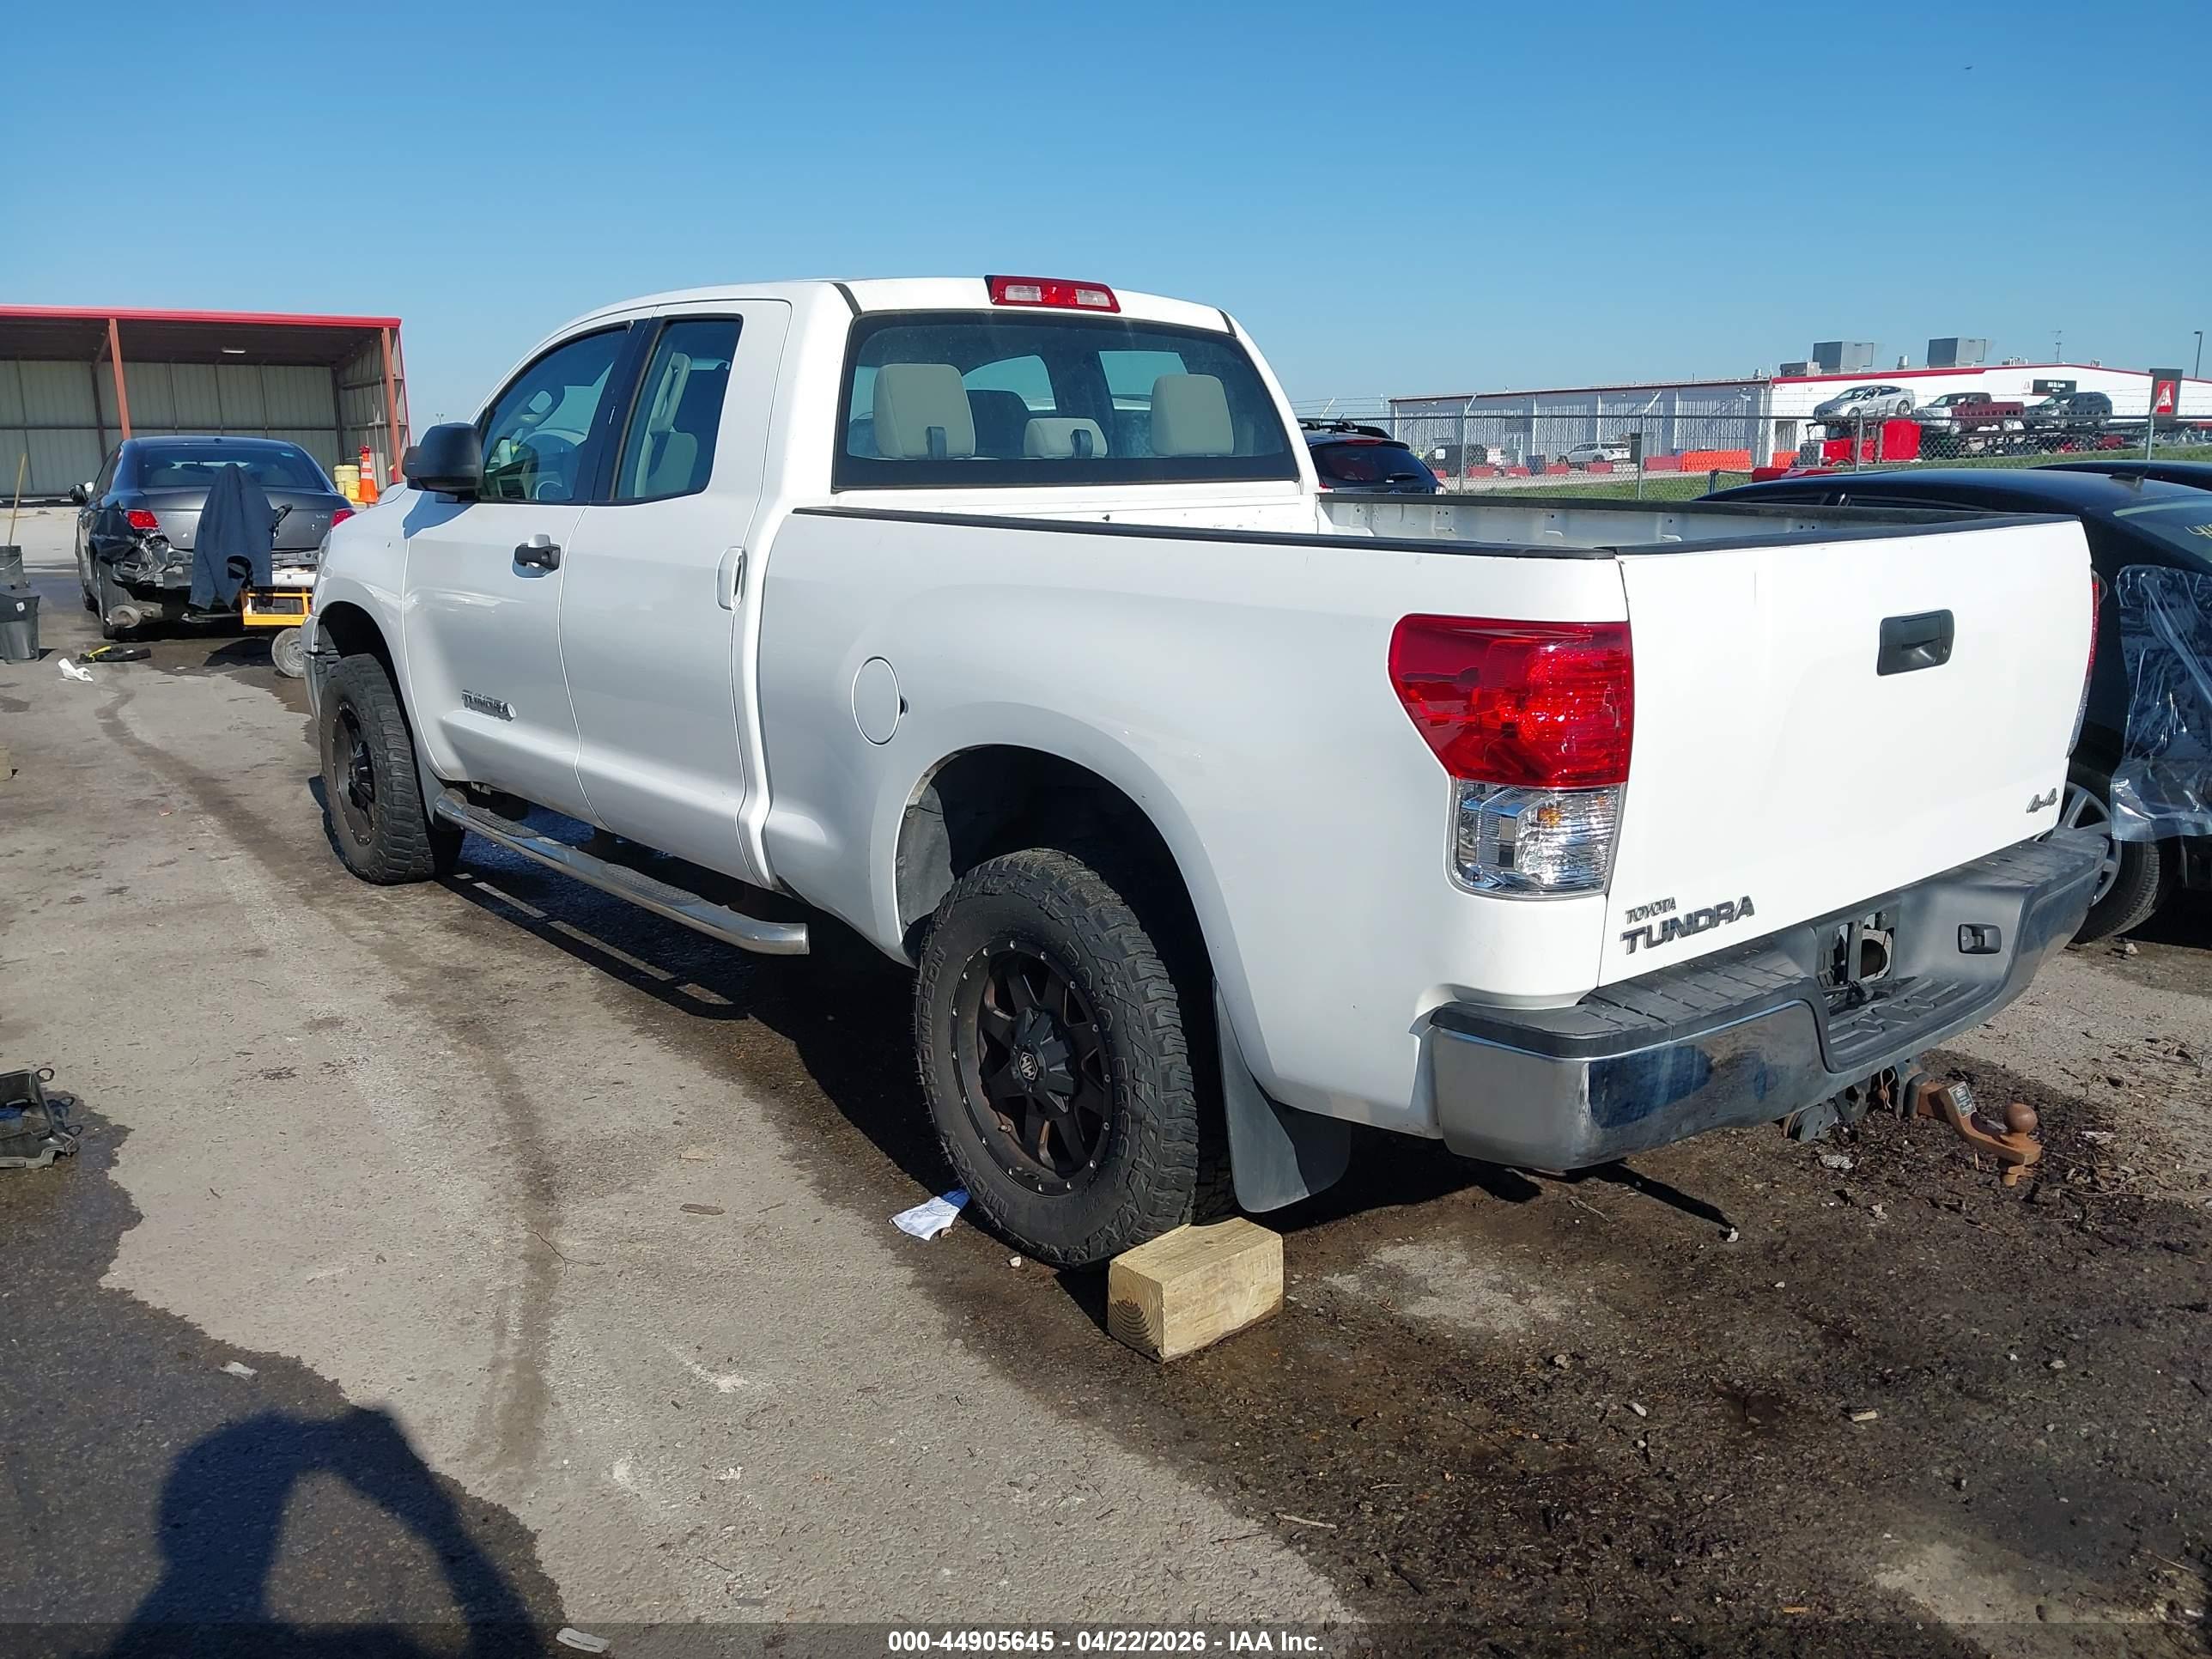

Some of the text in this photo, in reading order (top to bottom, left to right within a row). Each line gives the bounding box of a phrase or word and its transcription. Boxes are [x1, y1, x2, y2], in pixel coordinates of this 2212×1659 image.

[1620, 895, 1756, 956] TUNDRA
[1625, 896, 1677, 925] TOYOTA
[919, 945, 947, 1105] THOMPSON
